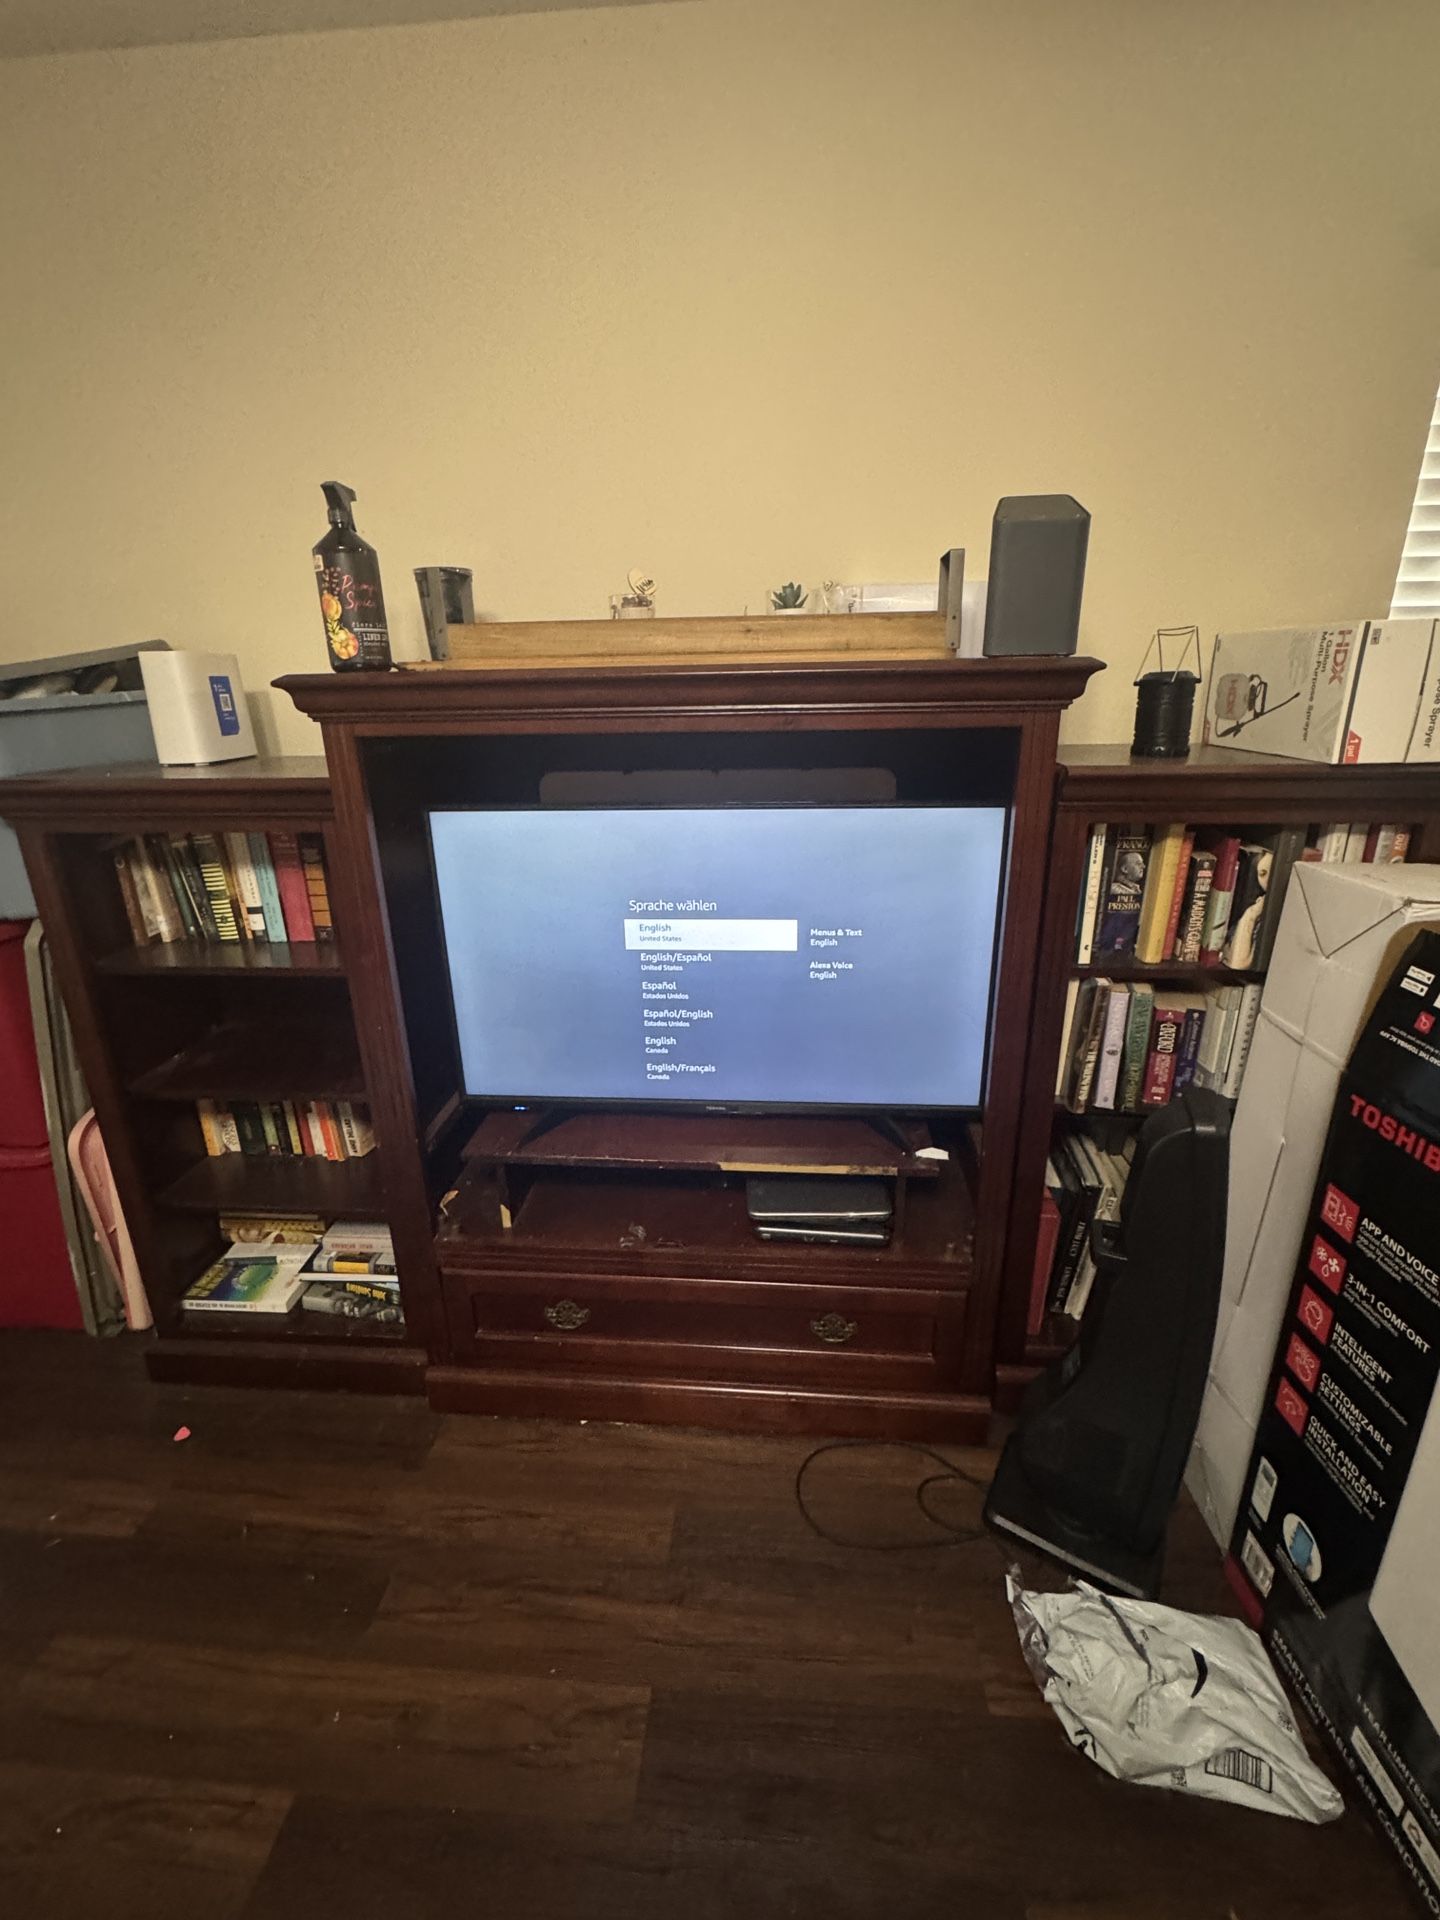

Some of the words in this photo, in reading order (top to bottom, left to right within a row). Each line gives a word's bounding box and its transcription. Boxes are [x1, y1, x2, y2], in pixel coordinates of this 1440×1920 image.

[1308, 631, 1328, 703] Multi-Purpose
[1320, 639, 1333, 673] Gallon
[1328, 629, 1353, 686] HDX
[1302, 705, 1314, 742] Sprayer
[1424, 707, 1440, 748] Sprayer
[629, 899, 674, 913] Sprache
[676, 899, 717, 912] wählen
[639, 923, 671, 934] English
[639, 935, 659, 943] United
[810, 928, 835, 937] Menus
[837, 928, 844, 936] &
[845, 928, 862, 937] Text
[810, 938, 838, 947] English
[640, 952, 712, 963] English/Español
[663, 964, 683, 972] States
[809, 961, 830, 970] Alexa
[832, 961, 853, 970] Voice
[642, 981, 677, 992] Español
[809, 971, 837, 980] English
[643, 1009, 713, 1019] Español/English
[668, 1020, 690, 1028] Unidos
[645, 1036, 676, 1046] English
[646, 1063, 716, 1074] English/Français
[1350, 1093, 1440, 1172] TOSHIB
[1361, 1217, 1382, 1236] APP
[1381, 1234, 1406, 1257] AND
[1406, 1251, 1439, 1287] VOICE
[1347, 1273, 1375, 1304] 3-IN-1
[1376, 1301, 1431, 1354] COMFORT
[1332, 1332, 1376, 1382] FEATURES
[1334, 1321, 1393, 1384] INTELLIGENT
[1320, 1381, 1361, 1433] SETTINGS
[1322, 1372, 1393, 1456] CUSTOMIZABLE
[1308, 1423, 1371, 1504] INSTALLATION
[1310, 1415, 1338, 1452] QUICK
[1338, 1450, 1359, 1477] AND
[1360, 1475, 1386, 1508] EASY
